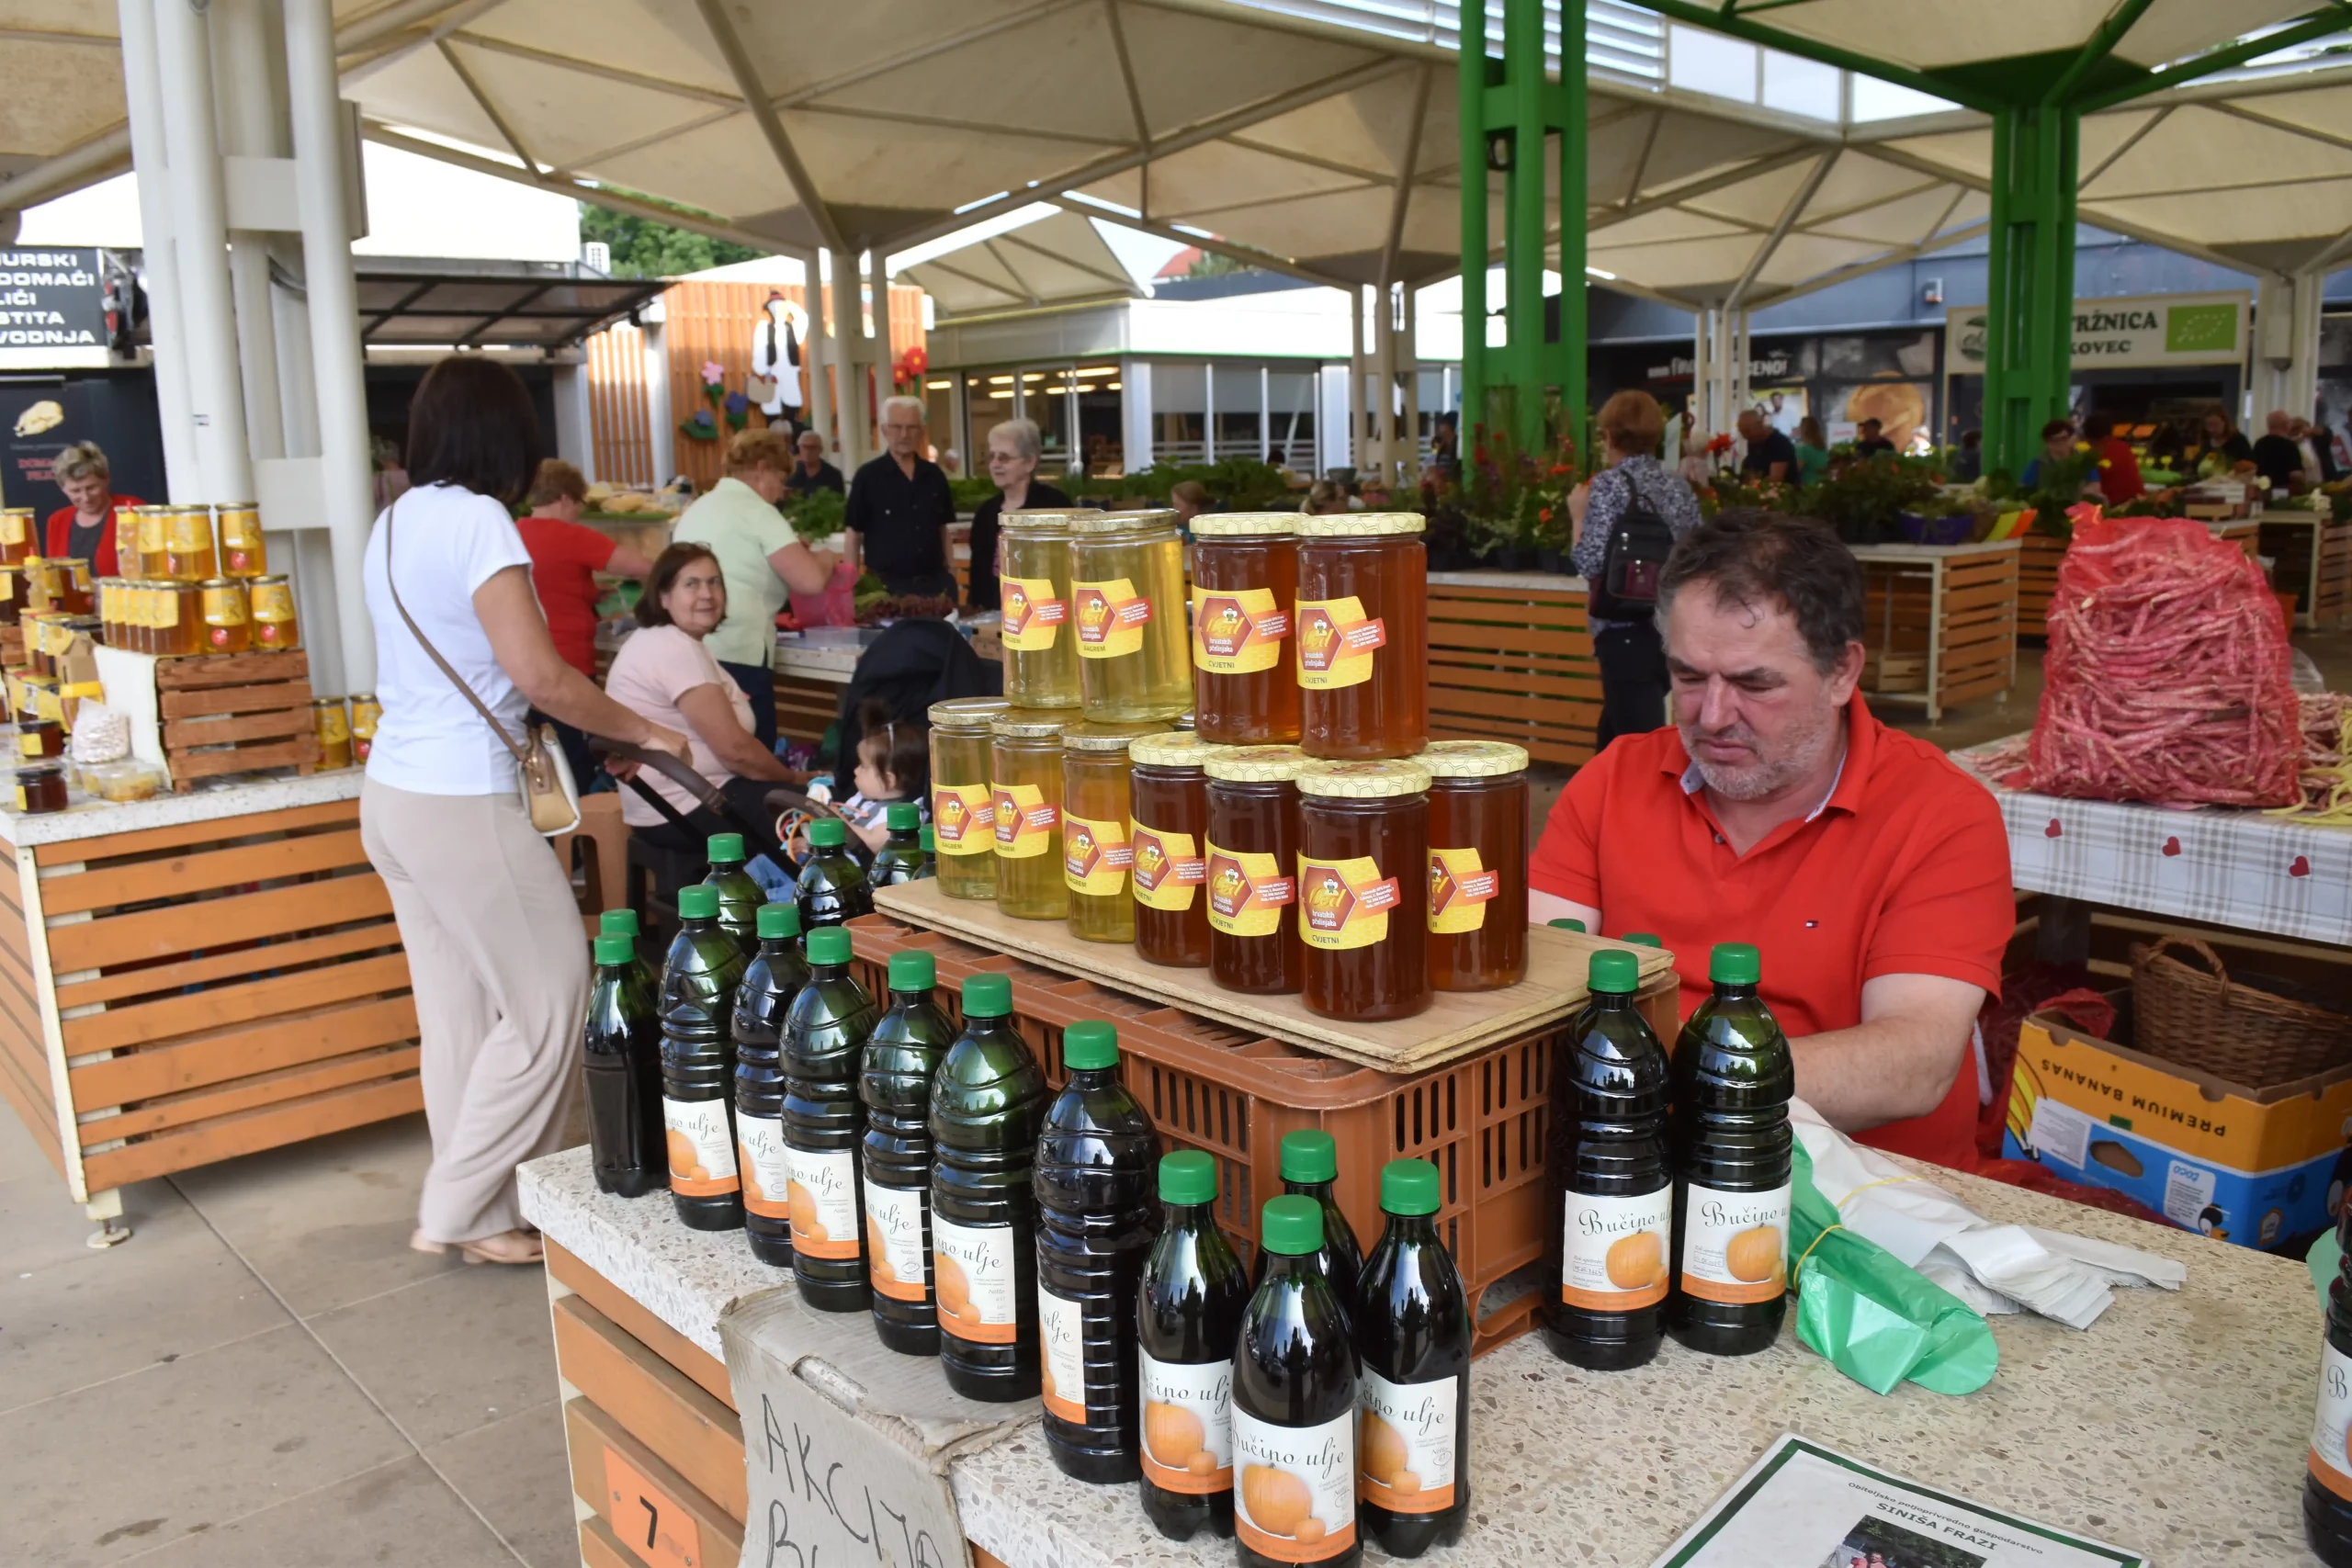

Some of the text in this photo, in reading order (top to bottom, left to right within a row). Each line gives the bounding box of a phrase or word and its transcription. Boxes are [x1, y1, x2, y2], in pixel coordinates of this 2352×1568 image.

[0, 253, 77, 266] URSKI
[2071, 309, 2158, 332] RŽNICA
[1208, 660, 1235, 669] CVJETNI
[1312, 934, 1340, 944] CVJETNI
[2041, 1058, 2124, 1101] BANANAS
[688, 1112, 723, 1141] ulje
[2132, 1095, 2227, 1137] PREMIUM
[749, 1131, 780, 1158] ulje
[810, 1166, 846, 1197] ulje
[879, 1203, 915, 1235] ulje
[1578, 1209, 1655, 1236] Bučino
[1702, 1201, 1778, 1228] Bučino
[964, 1241, 1004, 1276] ulje
[1044, 1310, 1074, 1345] ulje
[1199, 1374, 1231, 1416] ulj
[1403, 1395, 1450, 1437] ulje
[1306, 1437, 1349, 1480] ulje
[639, 1495, 659, 1550] 7
[1848, 1482, 2044, 1555] Obiteljsko poljoprivredno gospodarstvo
[1876, 1502, 1998, 1551] SINIŠA FRAZI
